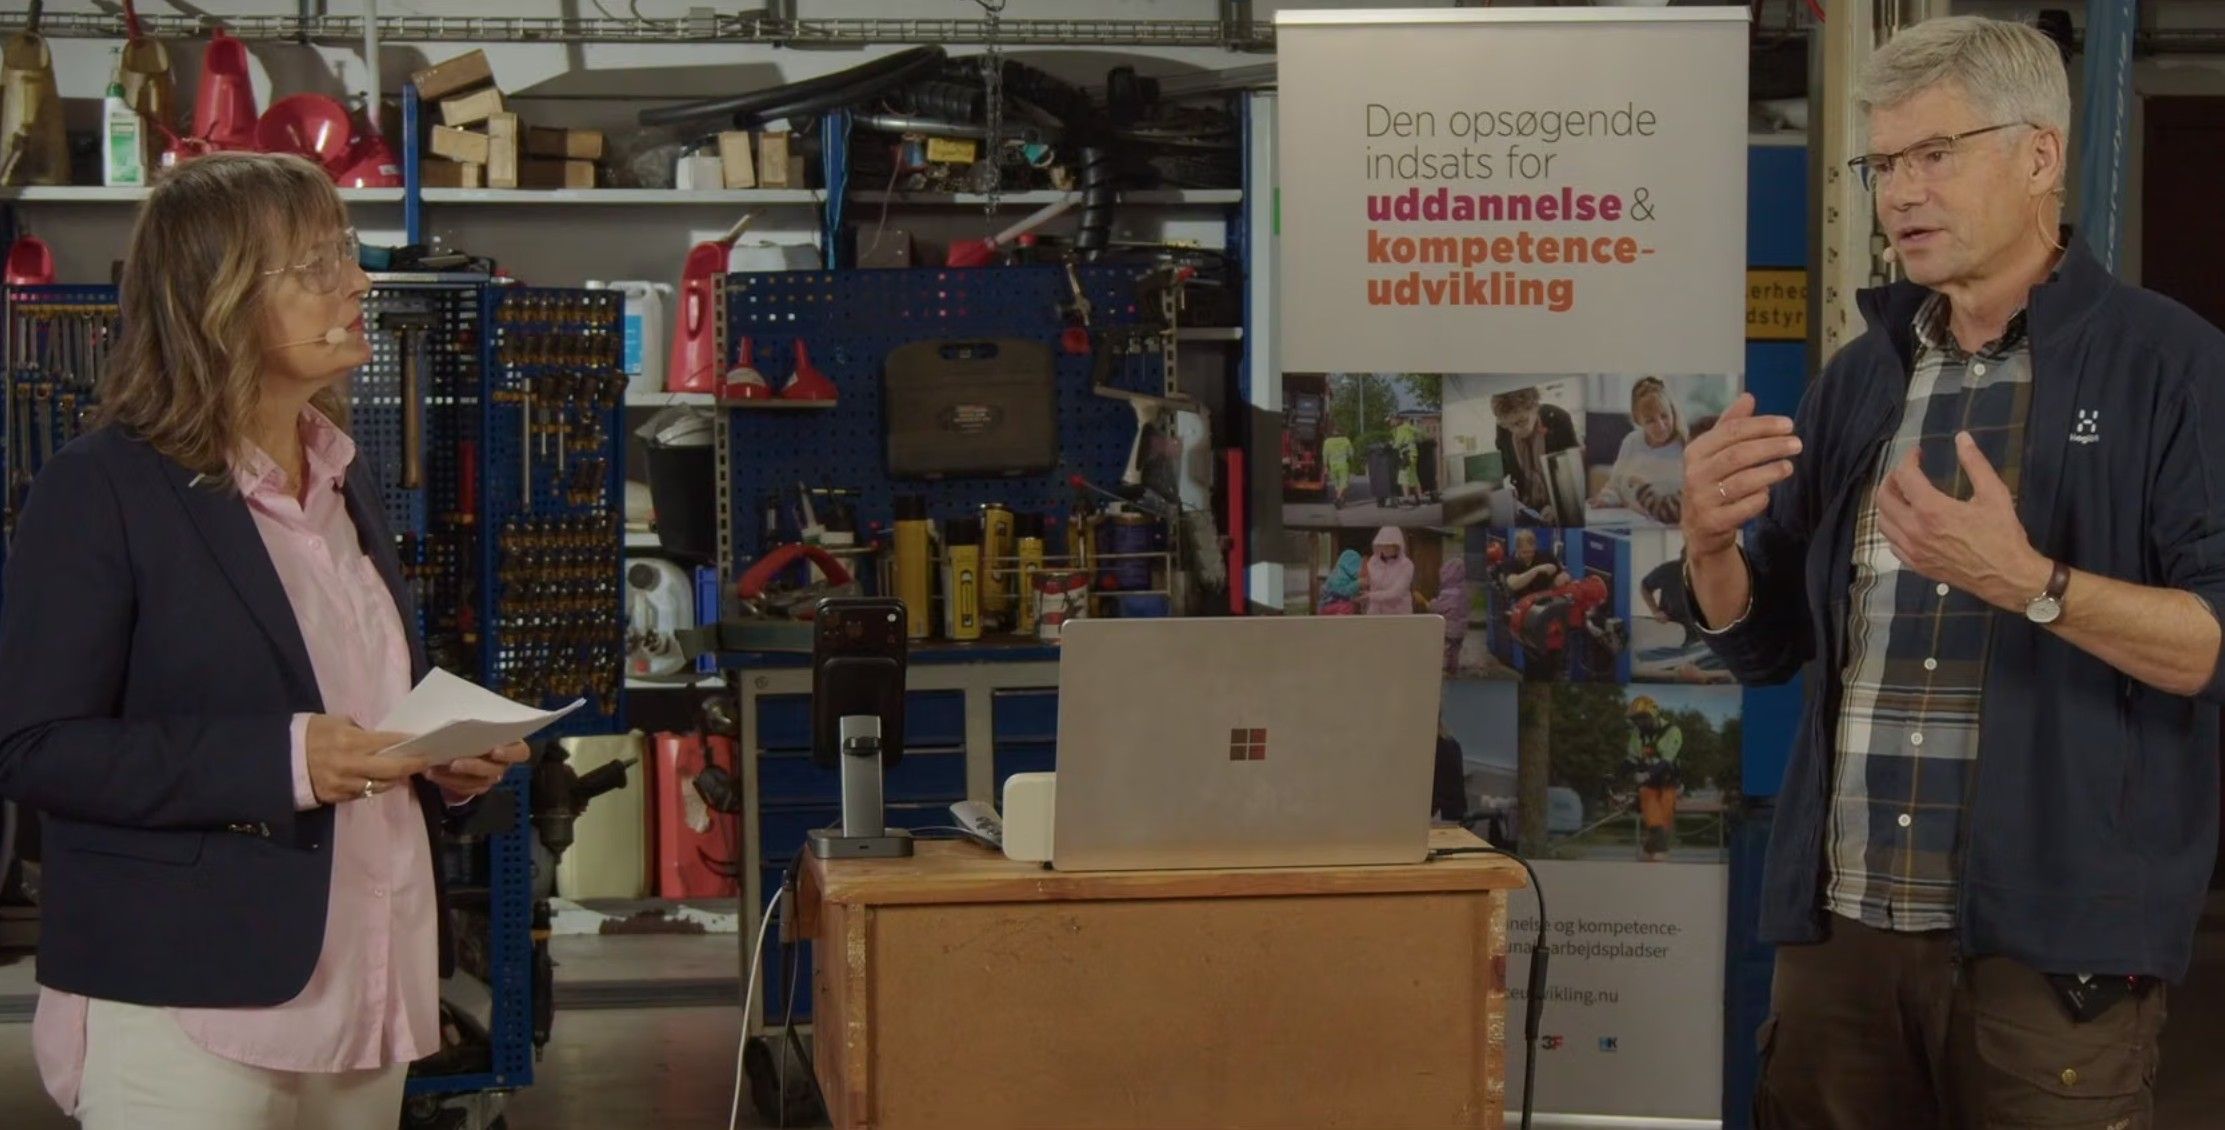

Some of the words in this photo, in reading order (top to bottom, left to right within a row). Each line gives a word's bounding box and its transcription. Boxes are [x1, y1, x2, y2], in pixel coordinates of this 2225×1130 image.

[1366, 103, 1436, 138] Den
[1448, 101, 1657, 143] opsøgende
[1366, 145, 1494, 180] indsats
[1506, 145, 1558, 180] for
[1366, 186, 1623, 222] uddannelse
[1629, 187, 1656, 222] &
[1366, 229, 1656, 268] kompetence-
[1366, 271, 1574, 313] udvikling
[1554, 920, 1575, 936] og
[1578, 918, 1682, 938] kompetence-
[1550, 940, 1669, 960] arbejdspladser
[1541, 1035, 1563, 1050] 3F
